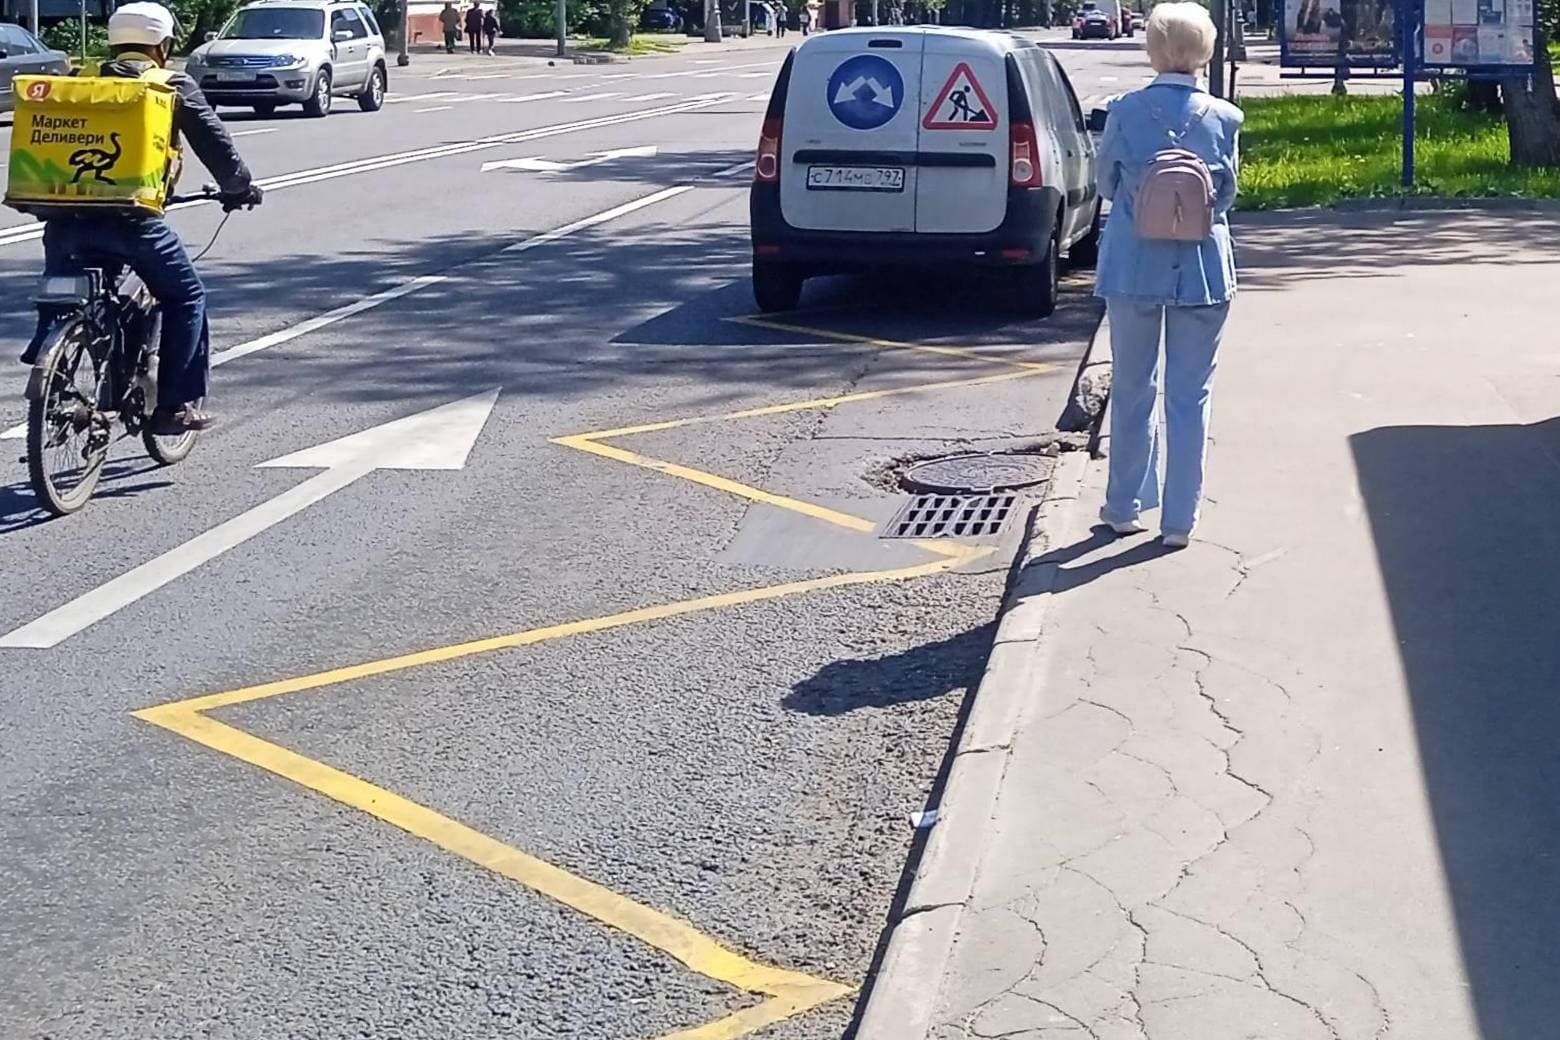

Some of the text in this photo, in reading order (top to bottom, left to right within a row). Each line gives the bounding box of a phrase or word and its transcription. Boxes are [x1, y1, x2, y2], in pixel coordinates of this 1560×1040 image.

[32, 83, 46, 97] Я
[31, 114, 88, 130] Маркет
[30, 129, 105, 146] Деливери
